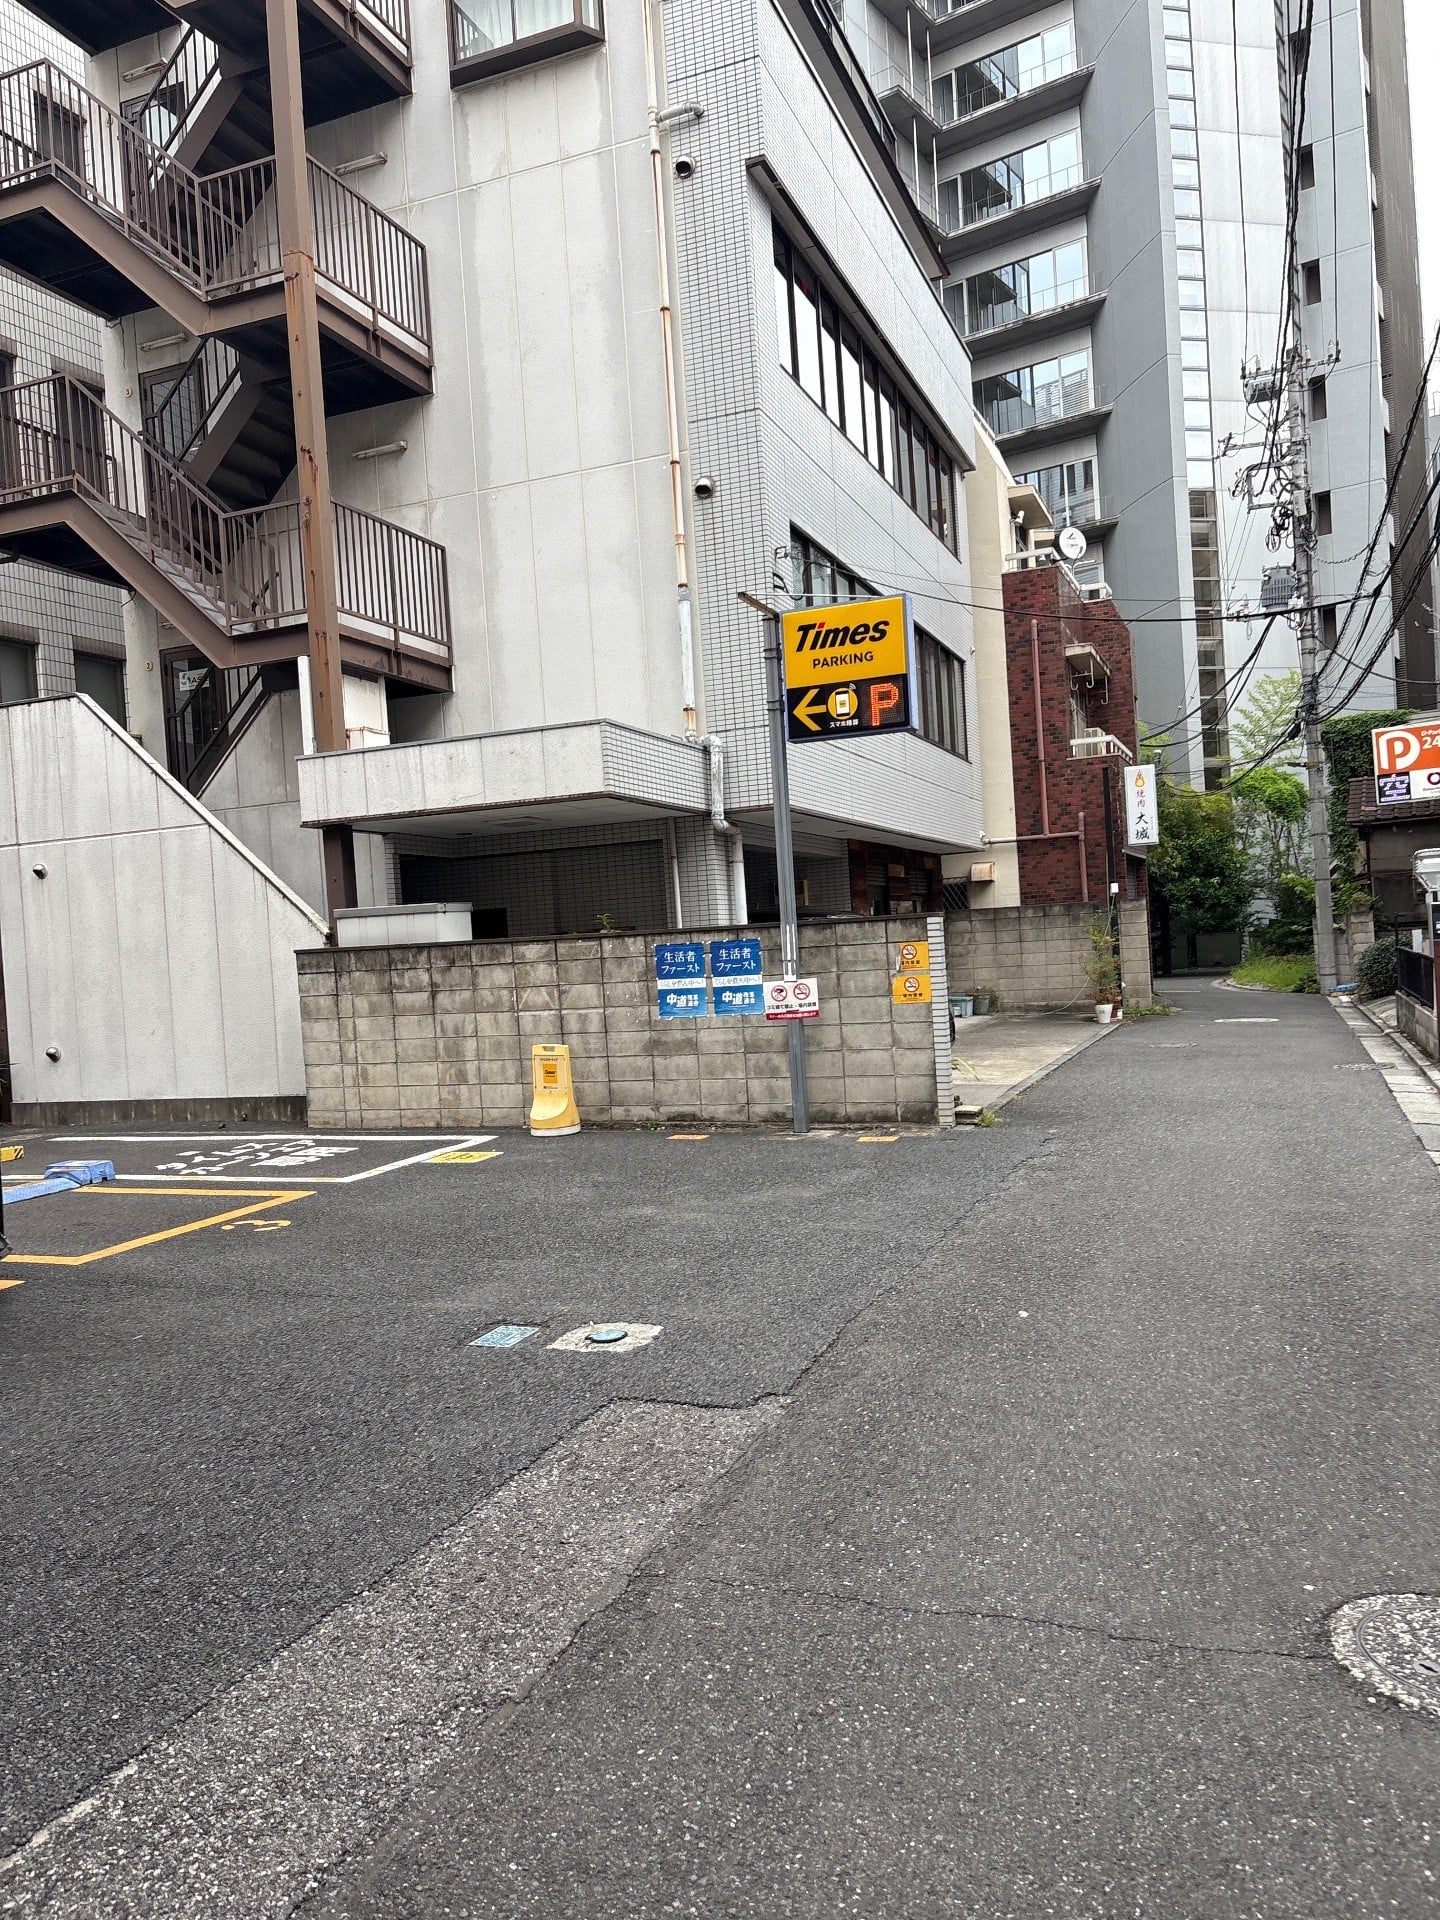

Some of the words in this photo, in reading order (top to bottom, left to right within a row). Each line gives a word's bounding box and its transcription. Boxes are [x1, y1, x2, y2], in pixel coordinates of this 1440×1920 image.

[796, 620, 889, 653] Times
[812, 650, 874, 669] PARKING
[870, 682, 899, 727] P
[1136, 789, 1146, 808] 焼肉
[1135, 811, 1150, 841] 大城
[663, 950, 697, 963] 生活者
[718, 947, 752, 960] 生活者
[660, 963, 700, 975] ファースト
[715, 959, 757, 972] ファースト
[666, 993, 687, 1008] 中道
[721, 990, 743, 1005] 中道
